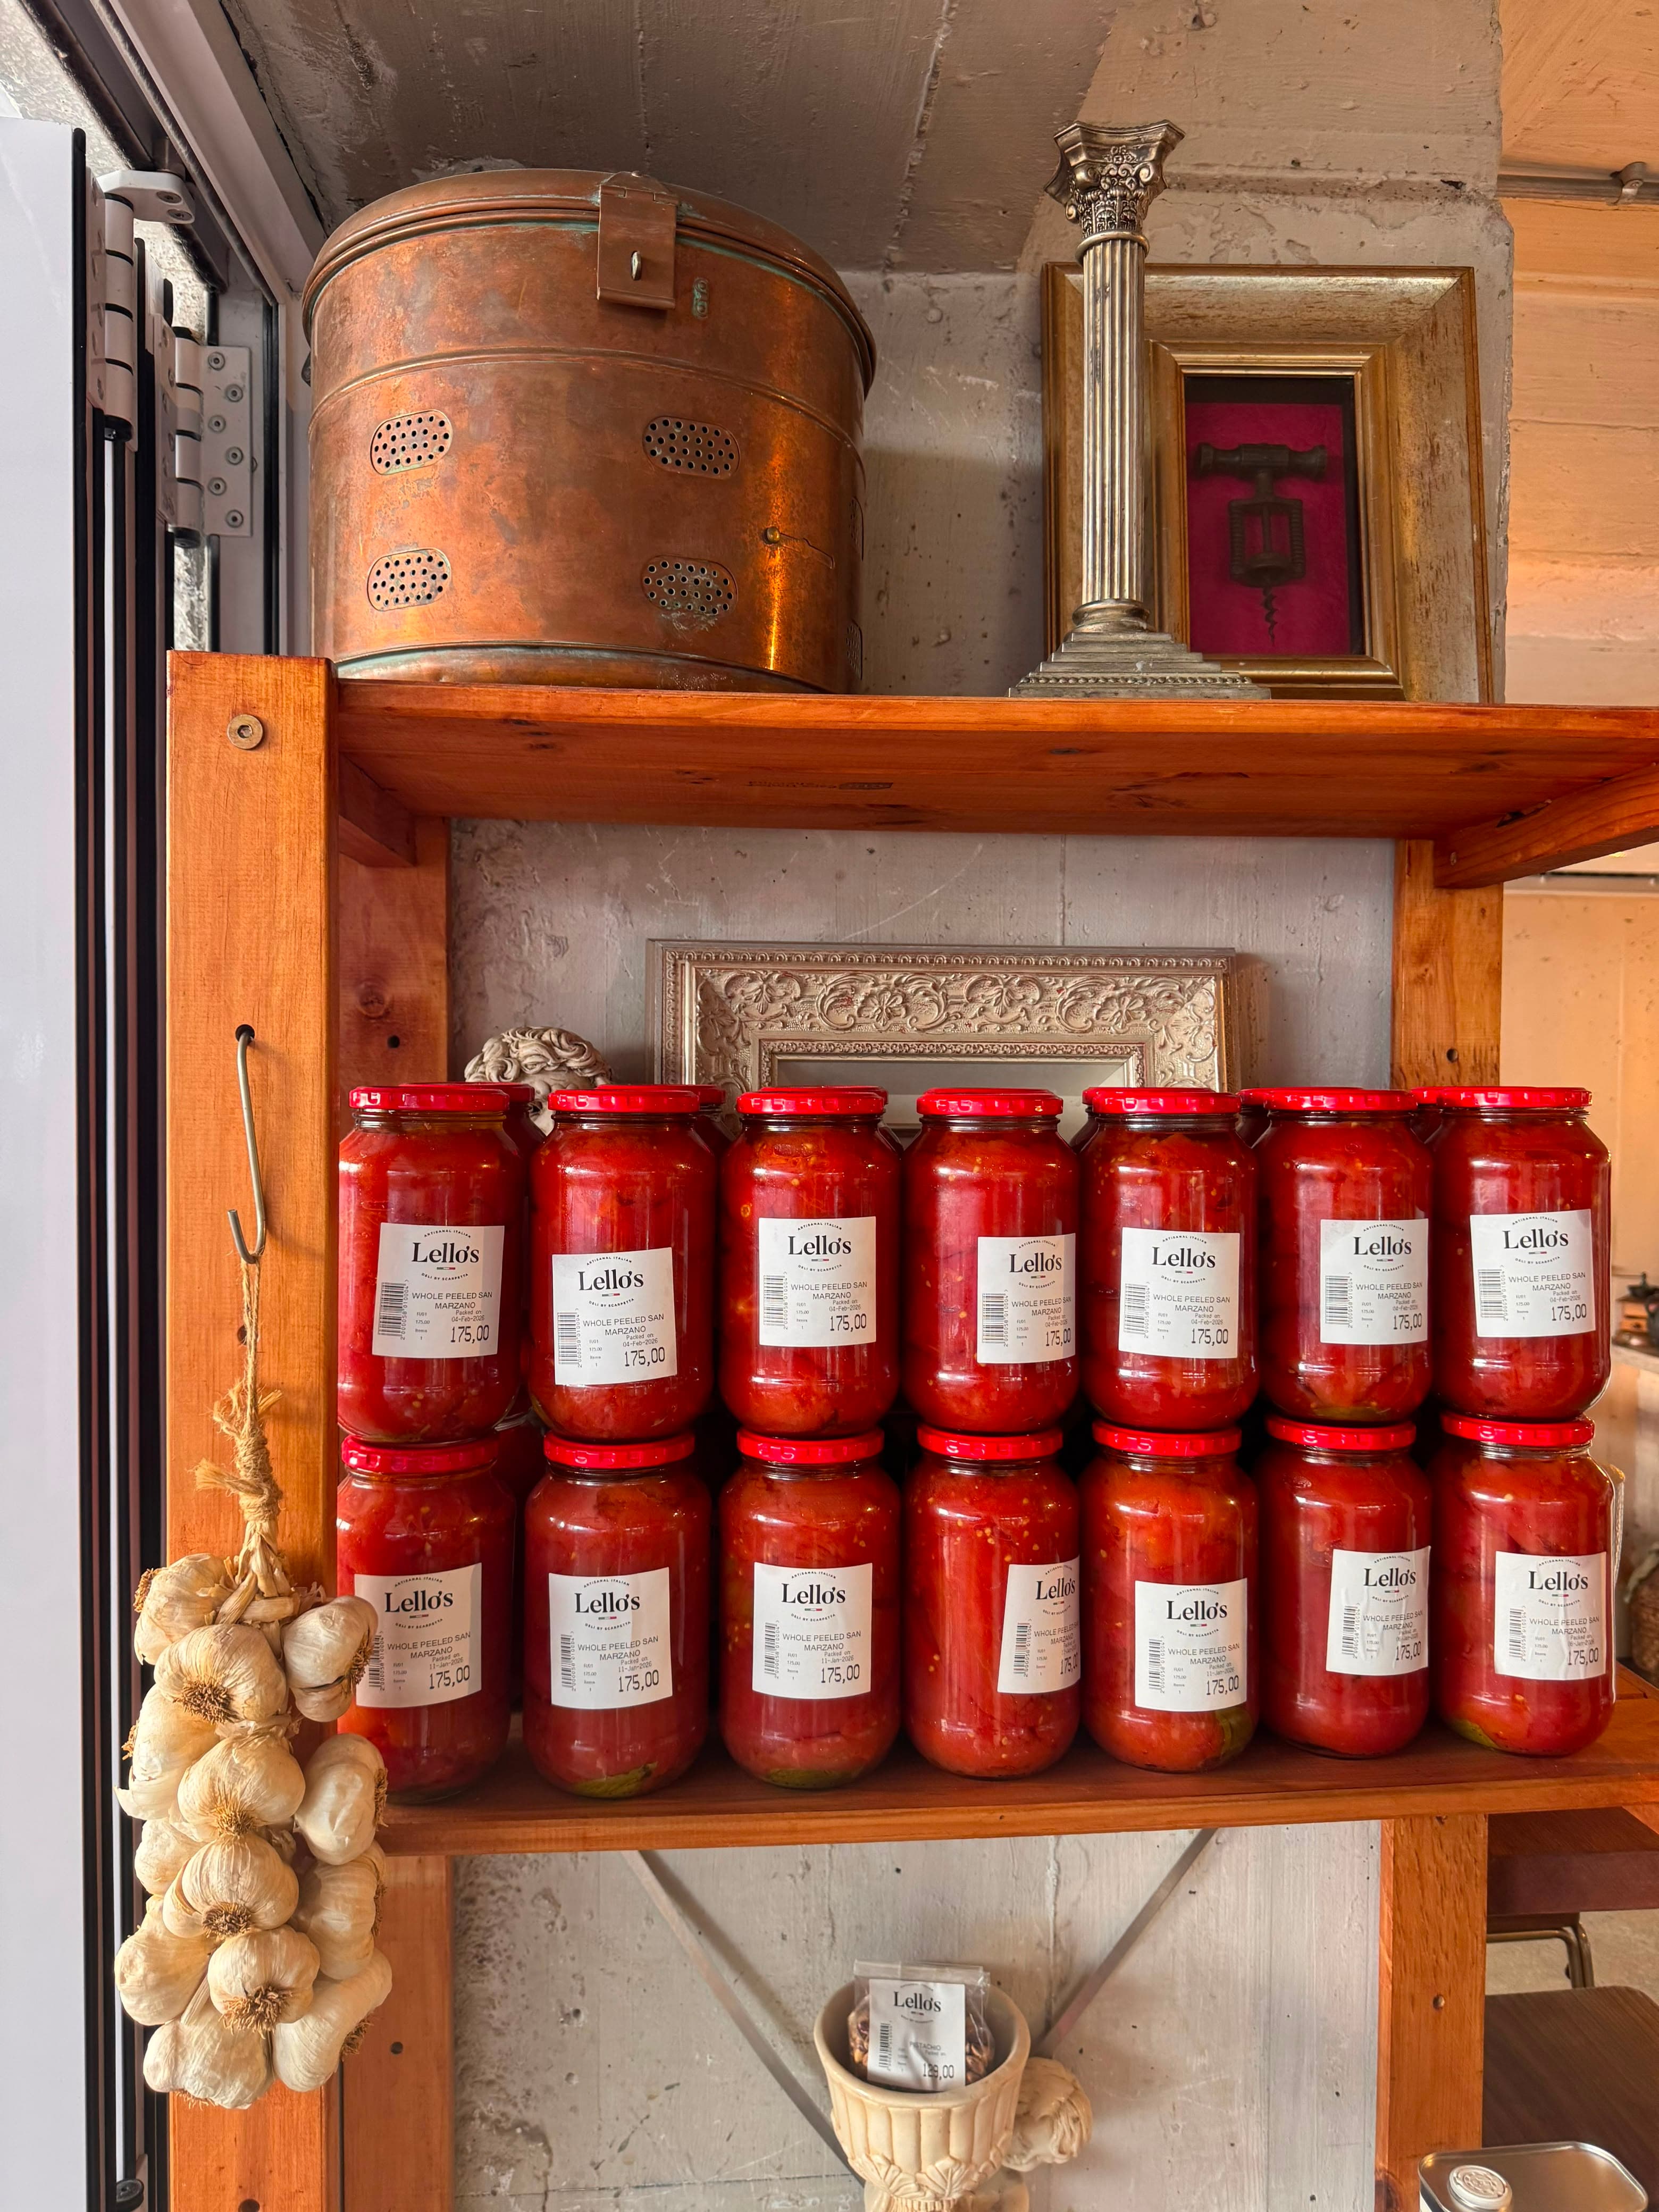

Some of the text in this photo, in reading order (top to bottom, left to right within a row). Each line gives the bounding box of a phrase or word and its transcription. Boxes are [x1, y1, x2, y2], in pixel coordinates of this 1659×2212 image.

[788, 1236, 851, 1255] Lello's
[1354, 1237, 1411, 1255] Lello's
[1503, 1229, 1569, 1249] Lello's
[412, 1242, 479, 1263] Lello's
[1152, 1247, 1216, 1268] Lello's
[1009, 1253, 1062, 1273] Lello's
[578, 1269, 643, 1291] Lello's
[614, 1316, 646, 1325] PEELED
[1032, 1308, 1061, 1316] MARZANO
[1552, 1304, 1587, 1322] 175,00
[605, 1326, 646, 1336] MARZANO
[830, 1314, 867, 1332] 175,00
[1393, 1313, 1422, 1331] 175,00
[451, 1325, 489, 1343] 175,00
[1046, 1328, 1070, 1347] 175,00
[1192, 1329, 1228, 1346] 175,00
[625, 1347, 665, 1367] 175,00
[1363, 1568, 1416, 1587] Lello's
[1529, 1571, 1588, 1590] Lello's
[782, 1583, 845, 1604] Lello's
[1036, 1577, 1075, 1600] Lello's
[385, 1590, 453, 1613] Lello's
[575, 1593, 640, 1613] Lello's
[1167, 1601, 1227, 1620] Lello's
[1034, 1629, 1057, 1637] WHOLE
[1382, 1622, 1413, 1630] MARZANO
[421, 1637, 453, 1648] PEELED
[455, 1631, 471, 1641] SAN
[609, 1640, 641, 1649] PEELED
[410, 1646, 453, 1659] MARZANO
[600, 1650, 641, 1661] MARZANO
[1199, 1646, 1227, 1655] PEELED
[1396, 1641, 1421, 1661] 175,00
[1568, 1647, 1599, 1668] 175,00
[1060, 1652, 1078, 1675] 175,0
[1190, 1656, 1226, 1665] MARZANO
[430, 1665, 470, 1689] 175,00
[619, 1670, 659, 1692] 175,00
[821, 1664, 860, 1683] 175,00
[1206, 1675, 1239, 1696] 175,00
[894, 1991, 941, 2012] Lello's
